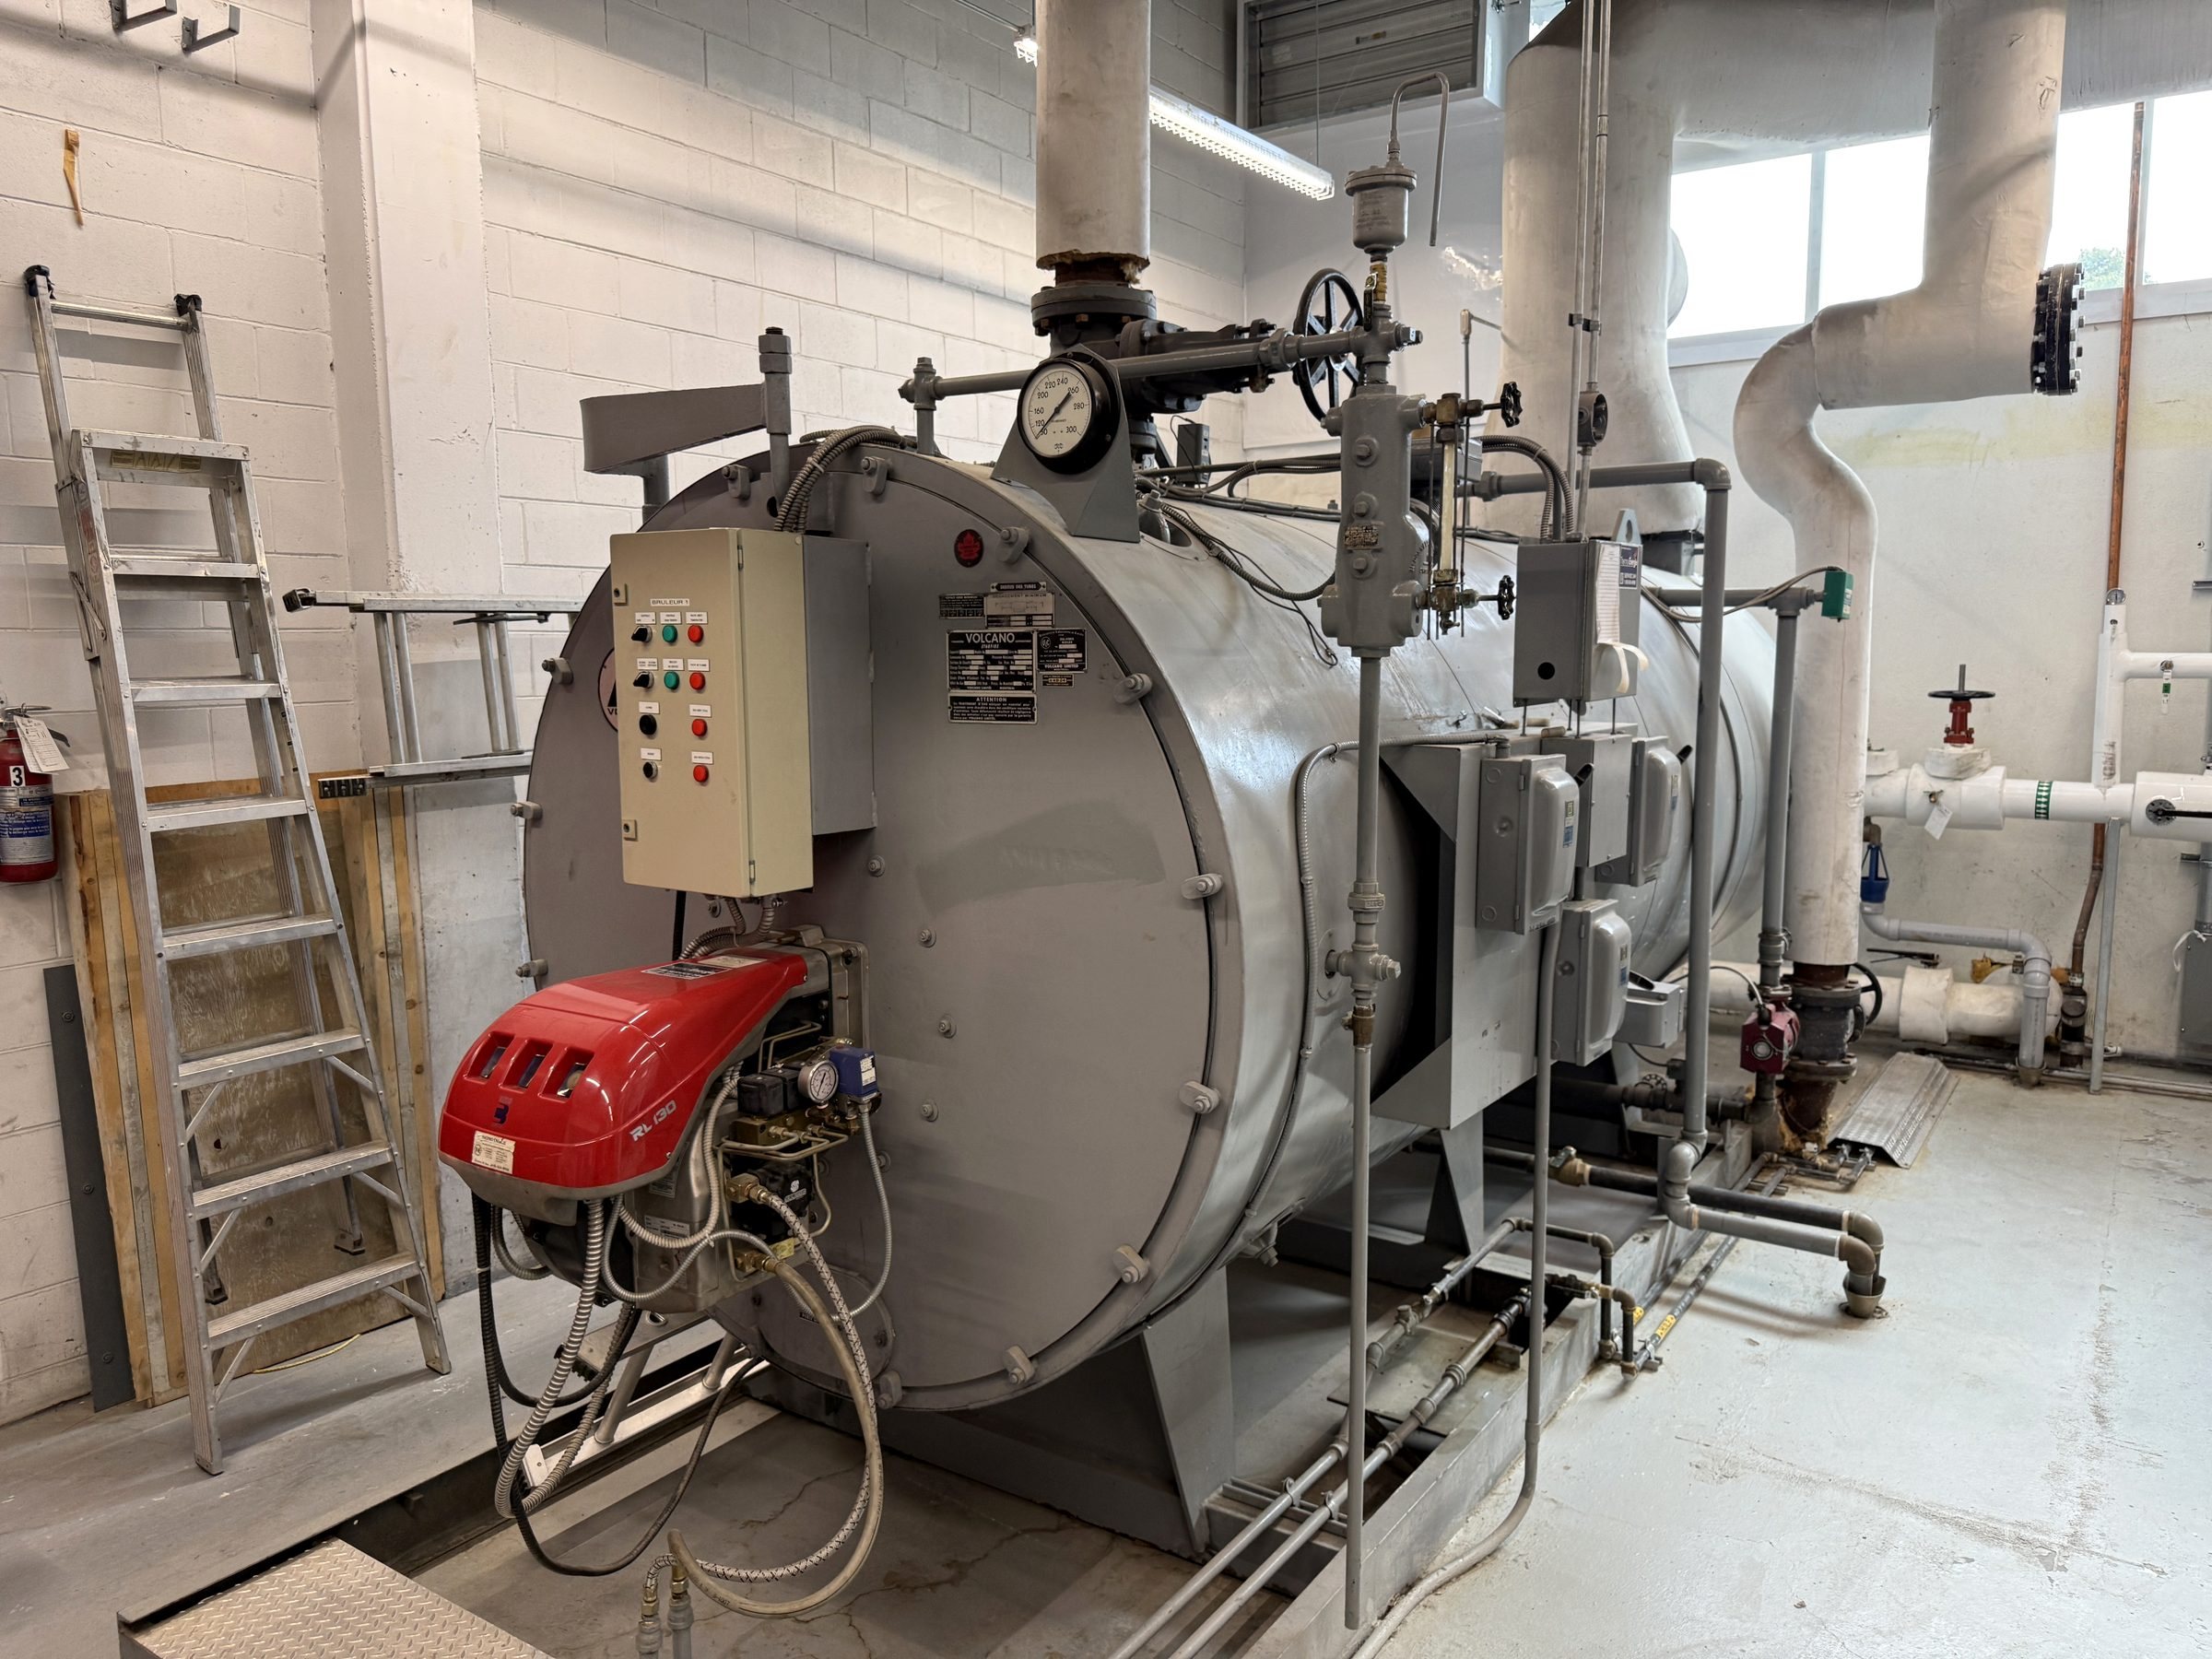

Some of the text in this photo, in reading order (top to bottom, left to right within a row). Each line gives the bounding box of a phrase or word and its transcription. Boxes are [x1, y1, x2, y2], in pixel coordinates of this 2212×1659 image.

[1044, 381, 1056, 389] 220
[1067, 386, 1079, 394] 260
[1037, 391, 1049, 399] 200
[1073, 402, 1085, 410] 280
[965, 632, 1016, 643] VOLCANO
[12, 767, 23, 786] 3
[629, 1100, 677, 1142] RL 130
